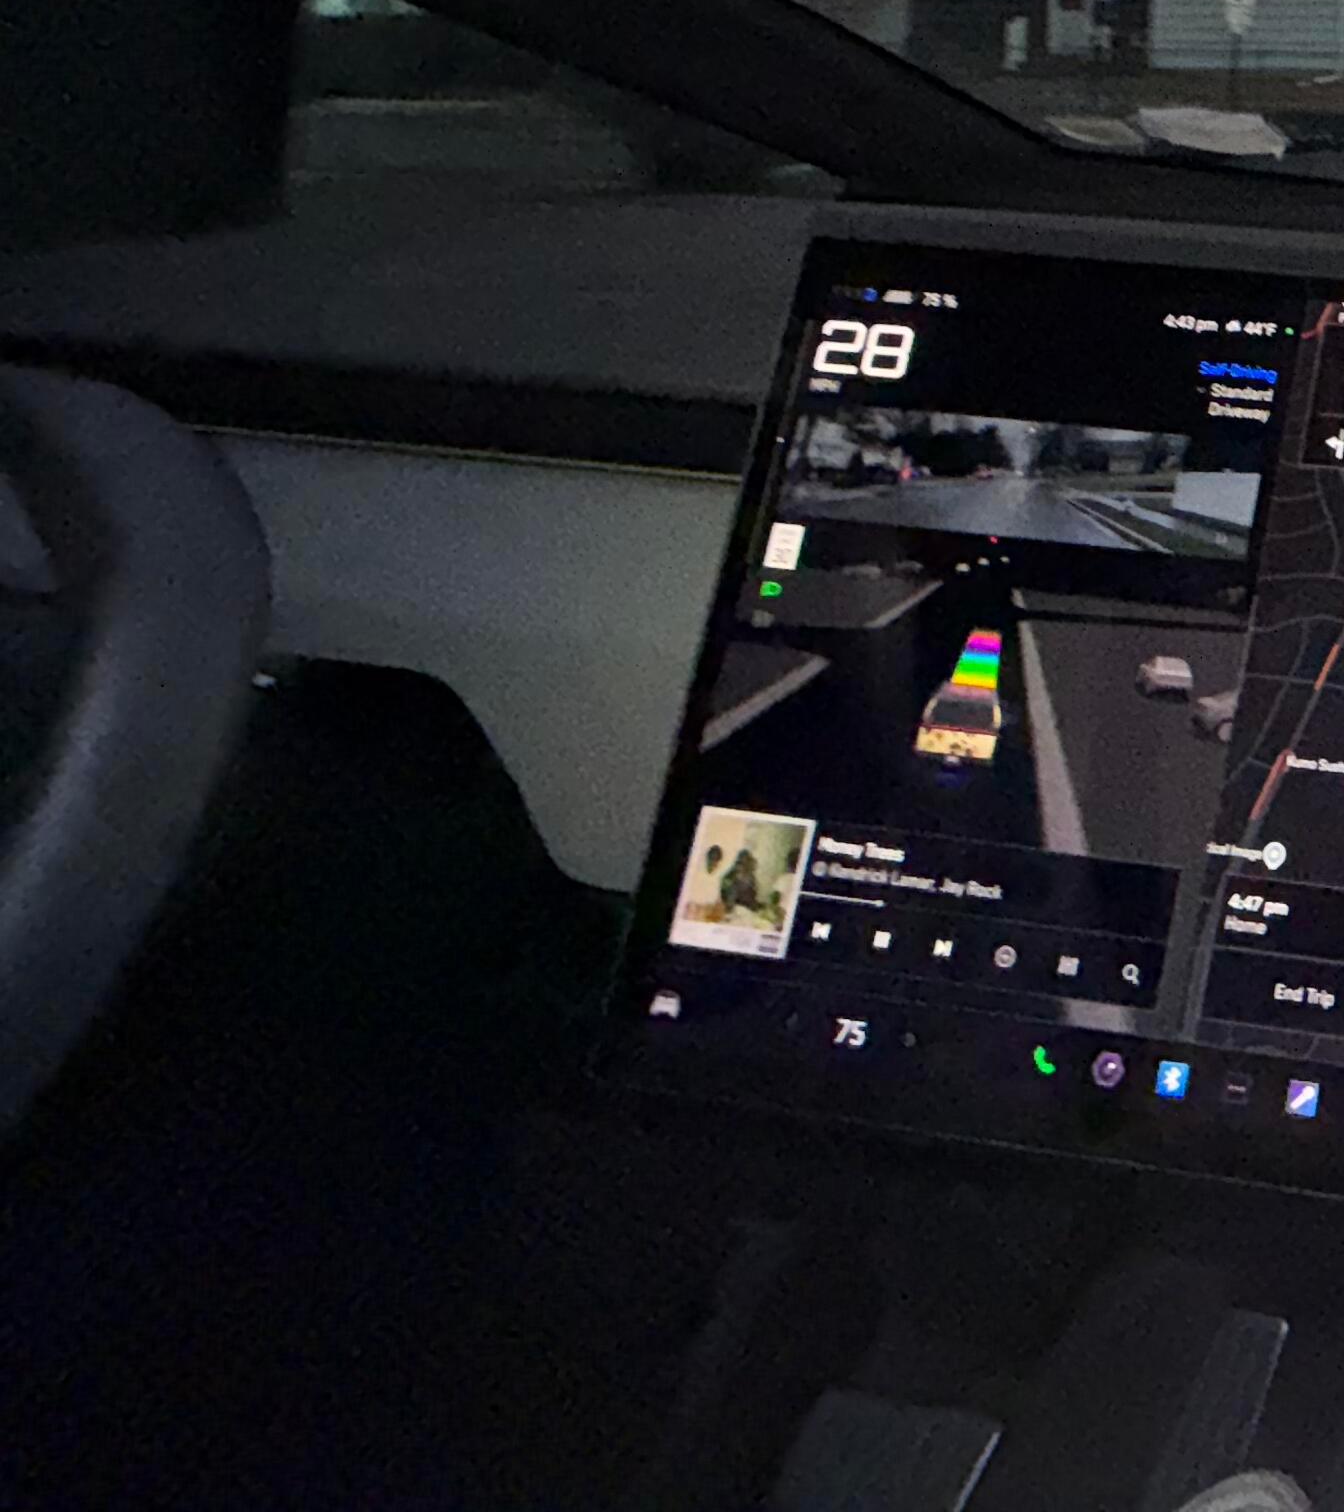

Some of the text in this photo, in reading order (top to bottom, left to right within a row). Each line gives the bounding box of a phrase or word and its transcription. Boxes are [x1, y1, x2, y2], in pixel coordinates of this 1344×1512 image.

[812, 319, 915, 379] 28
[1199, 360, 1278, 385] Self-Driving
[1273, 982, 1336, 1011] End Trip
[832, 1017, 868, 1047] 75
